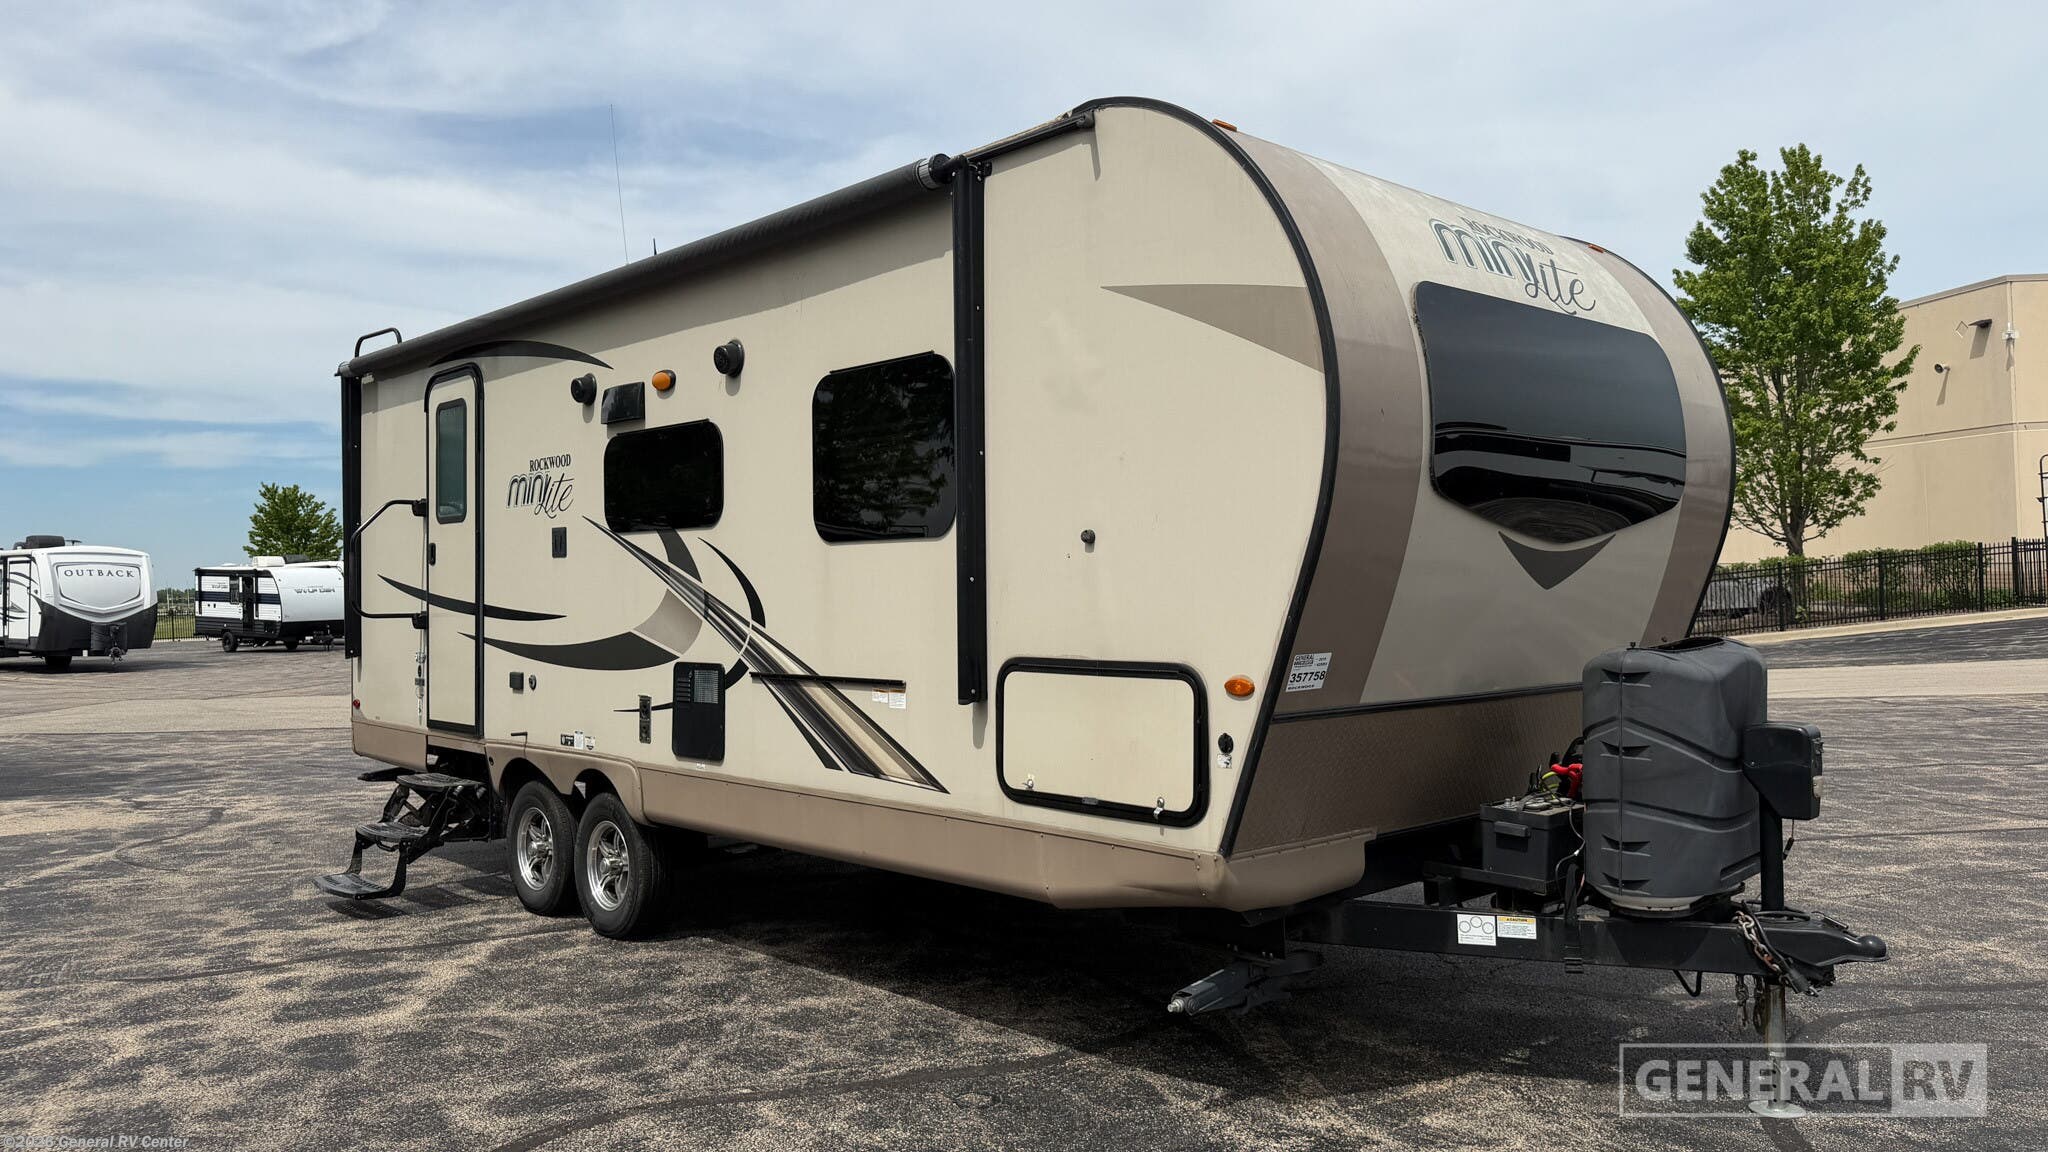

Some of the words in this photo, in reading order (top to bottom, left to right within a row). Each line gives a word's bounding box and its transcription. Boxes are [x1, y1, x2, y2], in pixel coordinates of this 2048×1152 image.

[1458, 216, 1554, 255] ROCKWOOD
[529, 454, 571, 471] ROCKWOOD
[64, 569, 135, 578] OUTBACK
[1290, 671, 1325, 683] 357758
